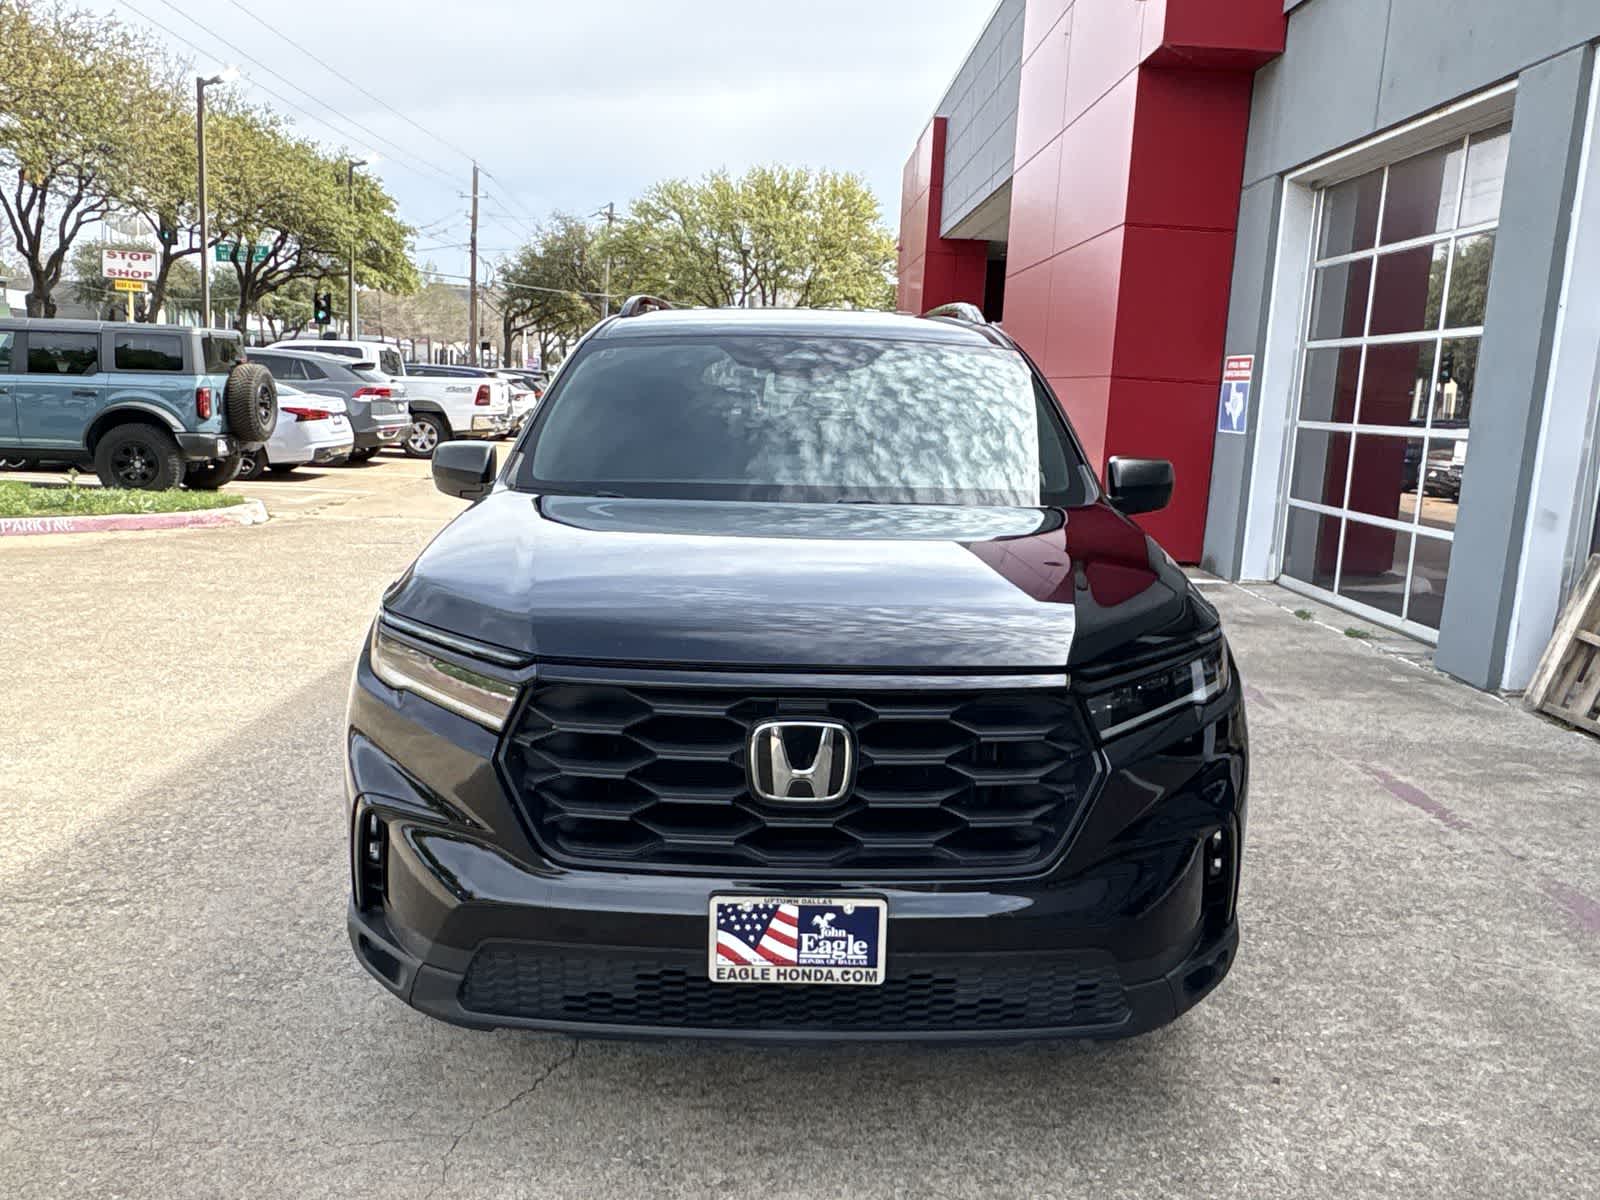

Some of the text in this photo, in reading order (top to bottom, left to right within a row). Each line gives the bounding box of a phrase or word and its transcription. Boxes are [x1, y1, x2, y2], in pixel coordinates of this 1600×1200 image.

[106, 250, 152, 261] STOP
[106, 268, 153, 279] SHOP
[0, 519, 75, 532] PARKING
[819, 926, 847, 939] John
[800, 933, 868, 960] Eagle
[716, 967, 878, 983] EAGLE HONDA.COM
